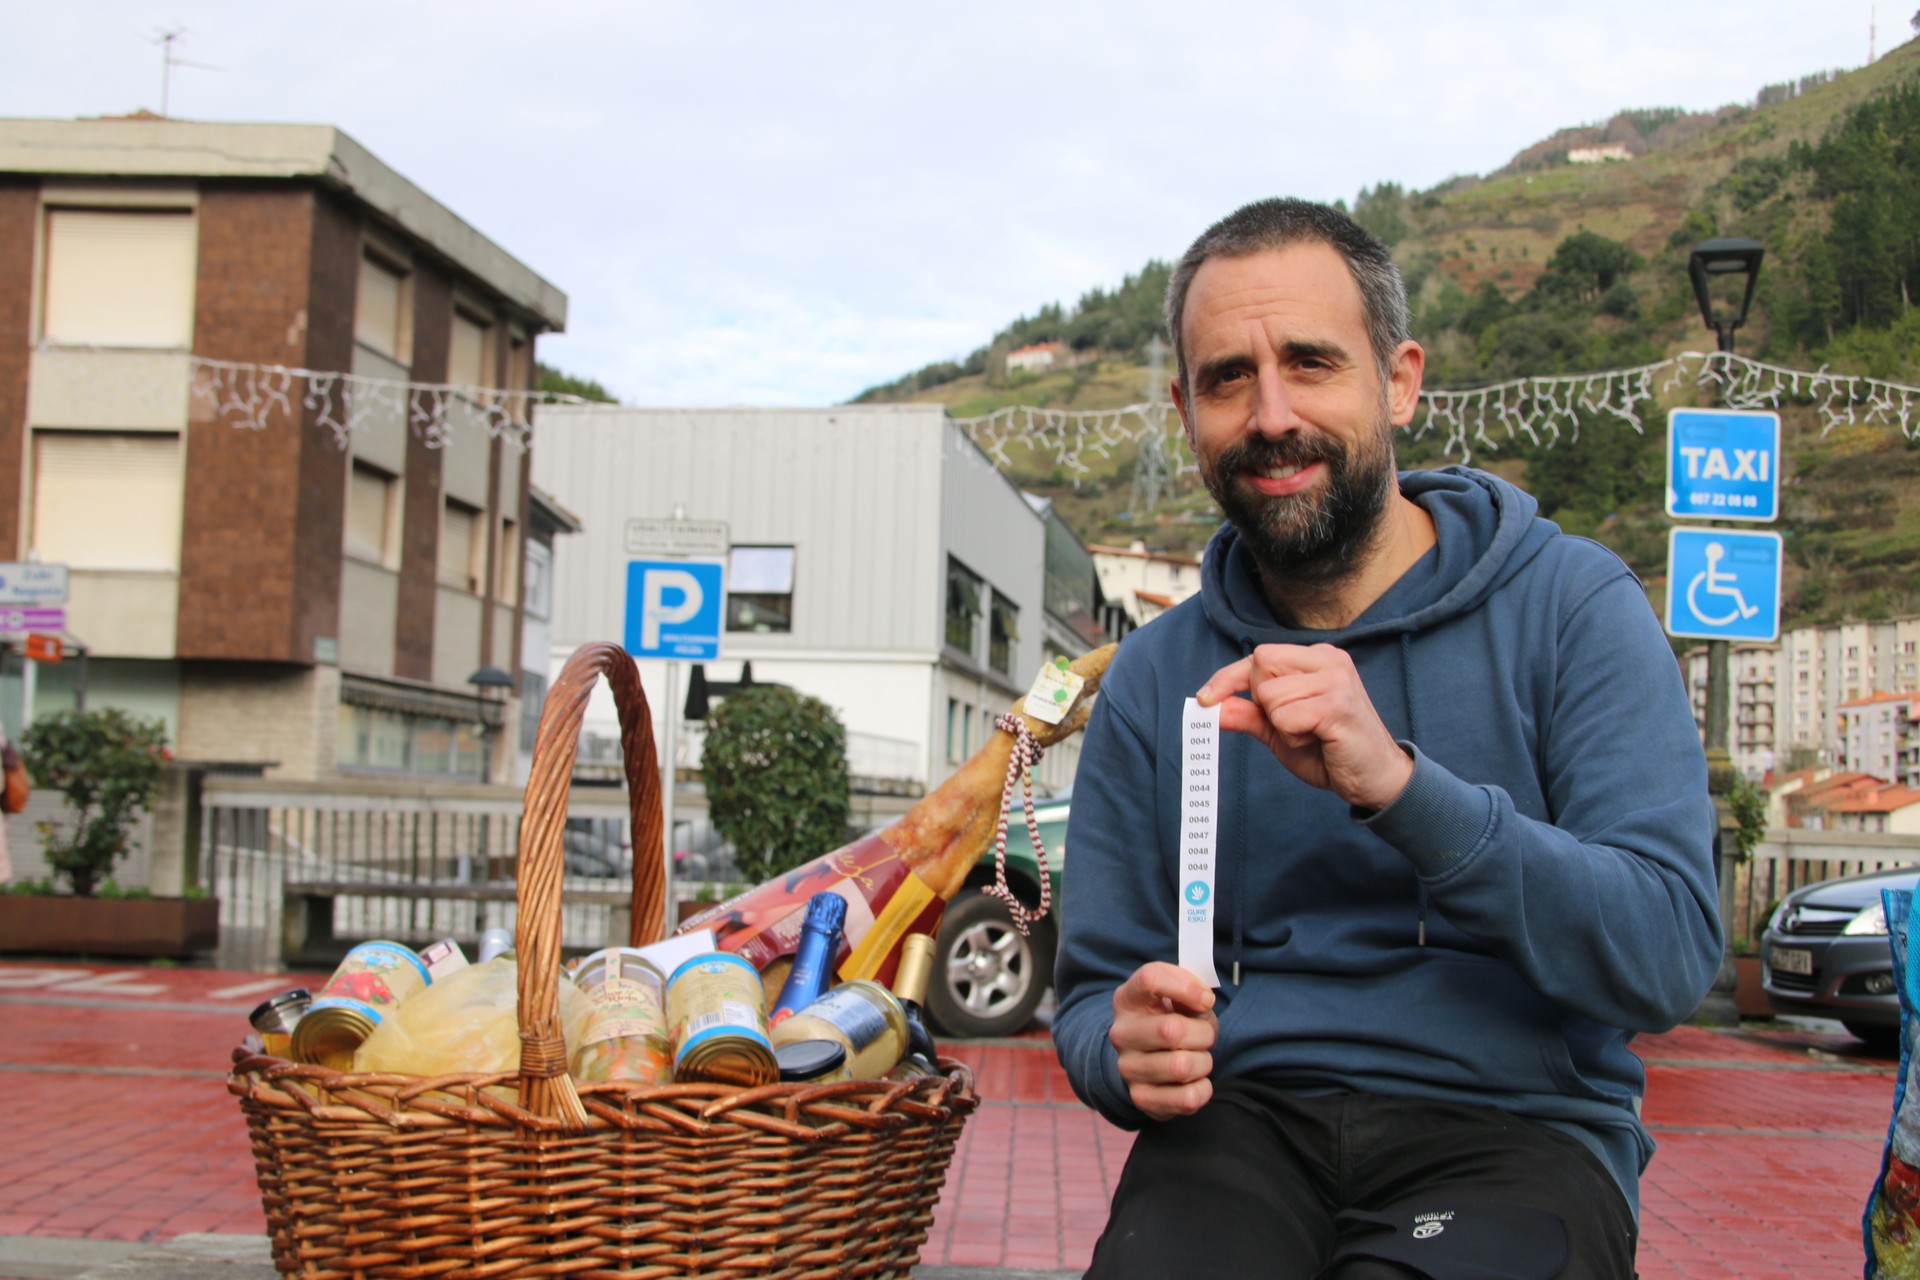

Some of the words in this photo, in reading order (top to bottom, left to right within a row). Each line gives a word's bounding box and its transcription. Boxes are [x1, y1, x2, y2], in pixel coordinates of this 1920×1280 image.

[1680, 447, 1769, 481] TAXI
[642, 570, 703, 649] P
[1190, 721, 1211, 729] 0040
[1190, 737, 1211, 745] 0041
[1190, 753, 1211, 761] 0042
[1190, 769, 1211, 777] 0043
[1189, 784, 1210, 792] 0044
[1189, 800, 1210, 808] 0045
[1189, 816, 1210, 824] 0046
[1188, 832, 1209, 840] 0047
[1188, 847, 1209, 855] 0048
[1188, 863, 1209, 871] 0049
